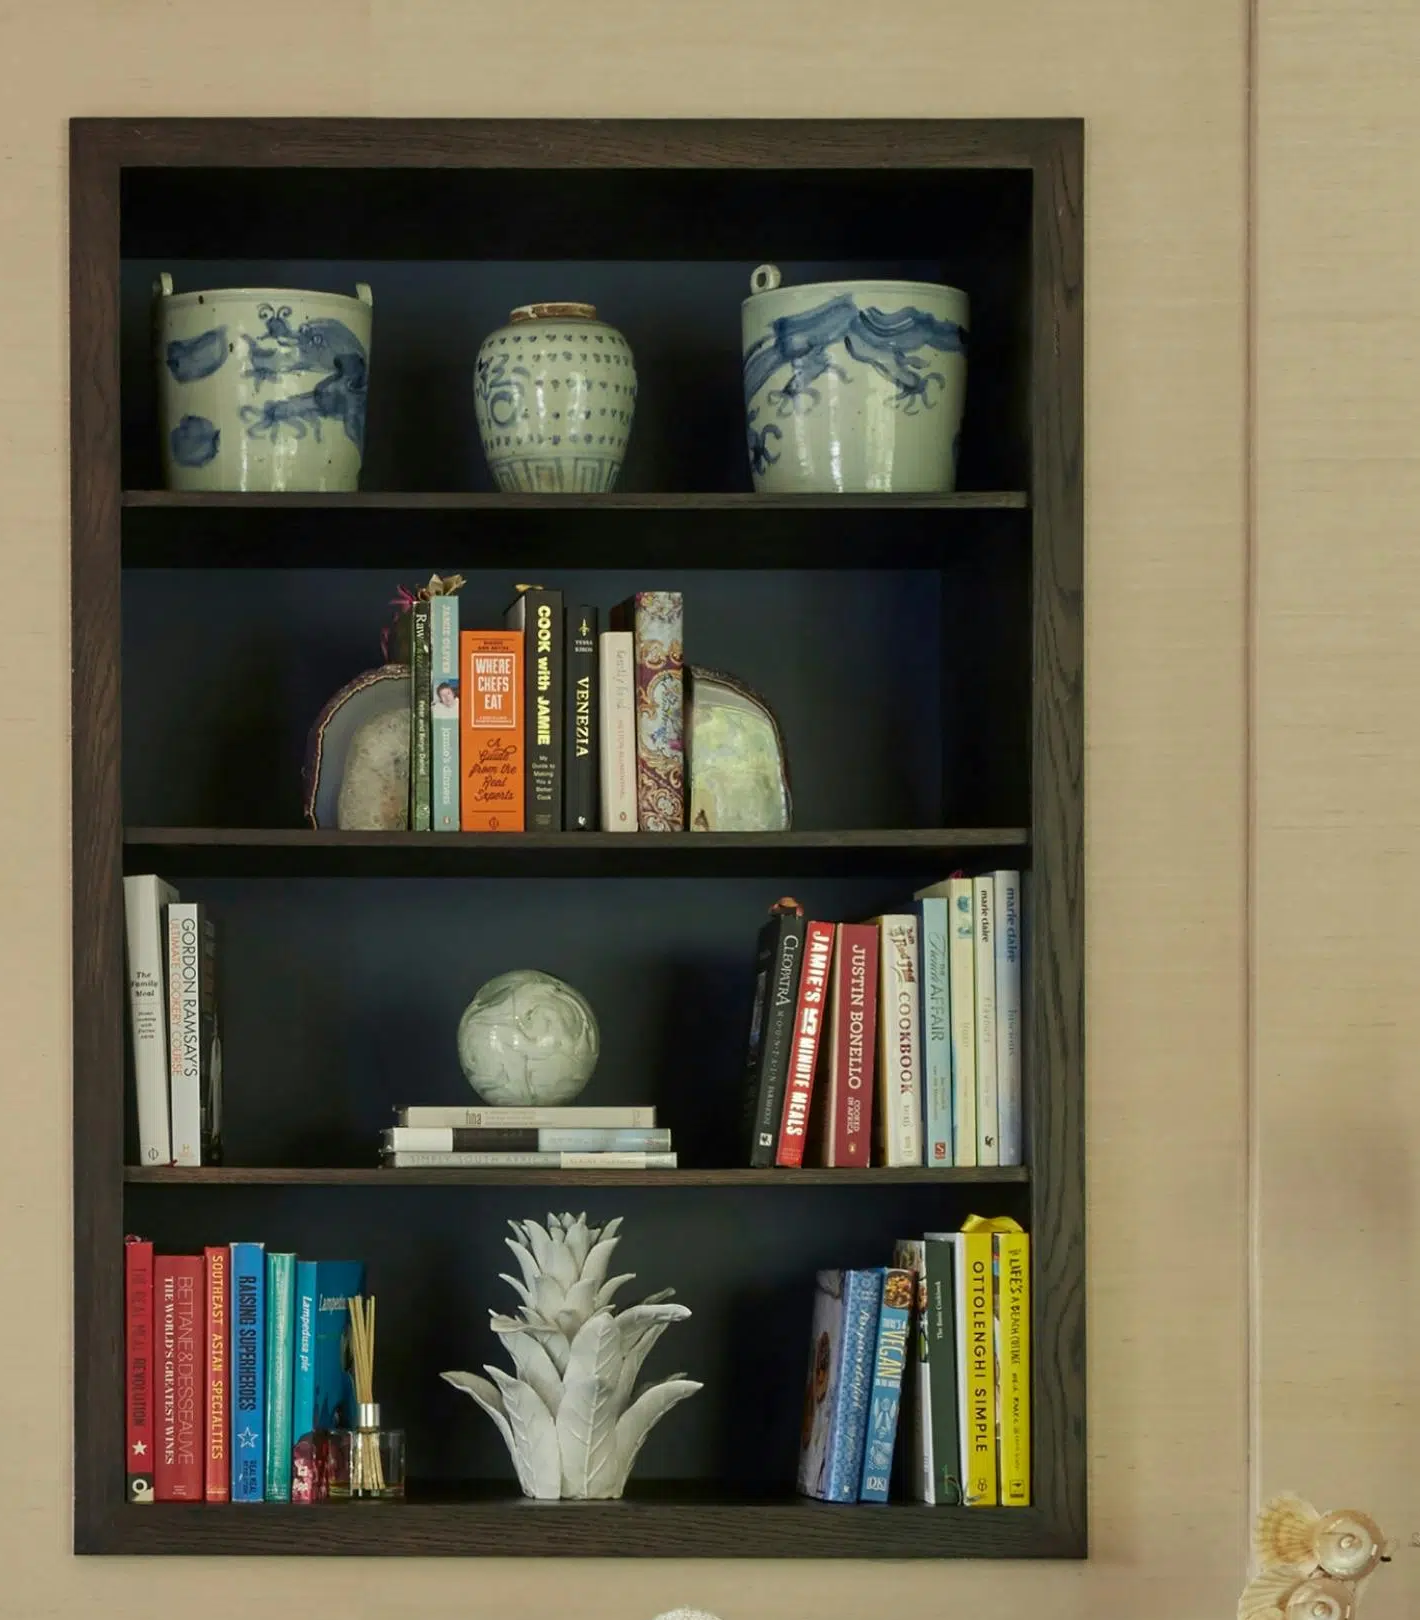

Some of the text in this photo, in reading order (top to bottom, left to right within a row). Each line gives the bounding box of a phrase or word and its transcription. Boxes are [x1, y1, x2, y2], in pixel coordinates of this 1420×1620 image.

[475, 657, 511, 675] WHERE
[477, 677, 509, 693] CHEFS
[537, 605, 551, 745] COOK with JAMIE
[484, 695, 503, 711] EAT
[575, 676, 590, 757] VENEZIA
[469, 764, 517, 777] from the
[479, 745, 517, 762] Guide
[474, 791, 514, 802] Experts
[482, 777, 507, 789] Real
[981, 890, 989, 943] marie claire
[1006, 887, 1017, 963] marie claire
[136, 971, 152, 979] The
[775, 935, 799, 1006] CLEOPATRA
[804, 931, 829, 1003] JAMIE'S
[170, 918, 183, 1076] ULTIMATE COOKERY COURSE
[181, 918, 198, 1077] GORDON RAMSAY'S
[848, 944, 866, 1089] JUSTIN BONELLO
[930, 983, 944, 1041] AFFAIR
[791, 1038, 816, 1089] MINUTE
[898, 990, 913, 1095] COOKBOOK
[786, 1091, 810, 1136] MEALS
[847, 1107, 855, 1135] AFRICA
[853, 1099, 861, 1131] COOKED
[934, 1281, 942, 1310] Cookbook
[1008, 1258, 1023, 1294] LIFE'S
[1010, 1296, 1020, 1304] A
[131, 1291, 147, 1319] REAL
[1010, 1304, 1021, 1335] BEACH
[131, 1324, 147, 1351] MEAL
[211, 1255, 224, 1460] SOUTHEAST ASIAN SPECIALTIES
[238, 1275, 257, 1412] RAISING SUPERHEROES
[300, 1296, 312, 1373] Lampedusa pie
[876, 1329, 905, 1378] VEGAN
[936, 1327, 944, 1340] The
[973, 1261, 988, 1452] OTTOLENGHI SIMPLE
[1010, 1336, 1021, 1365] COTTAGE
[131, 1358, 147, 1426] REVOLUTION
[164, 1276, 174, 1465] THE WORLD'S GREATEST WINES
[177, 1276, 194, 1465] BETTANE&DESSEAUVE
